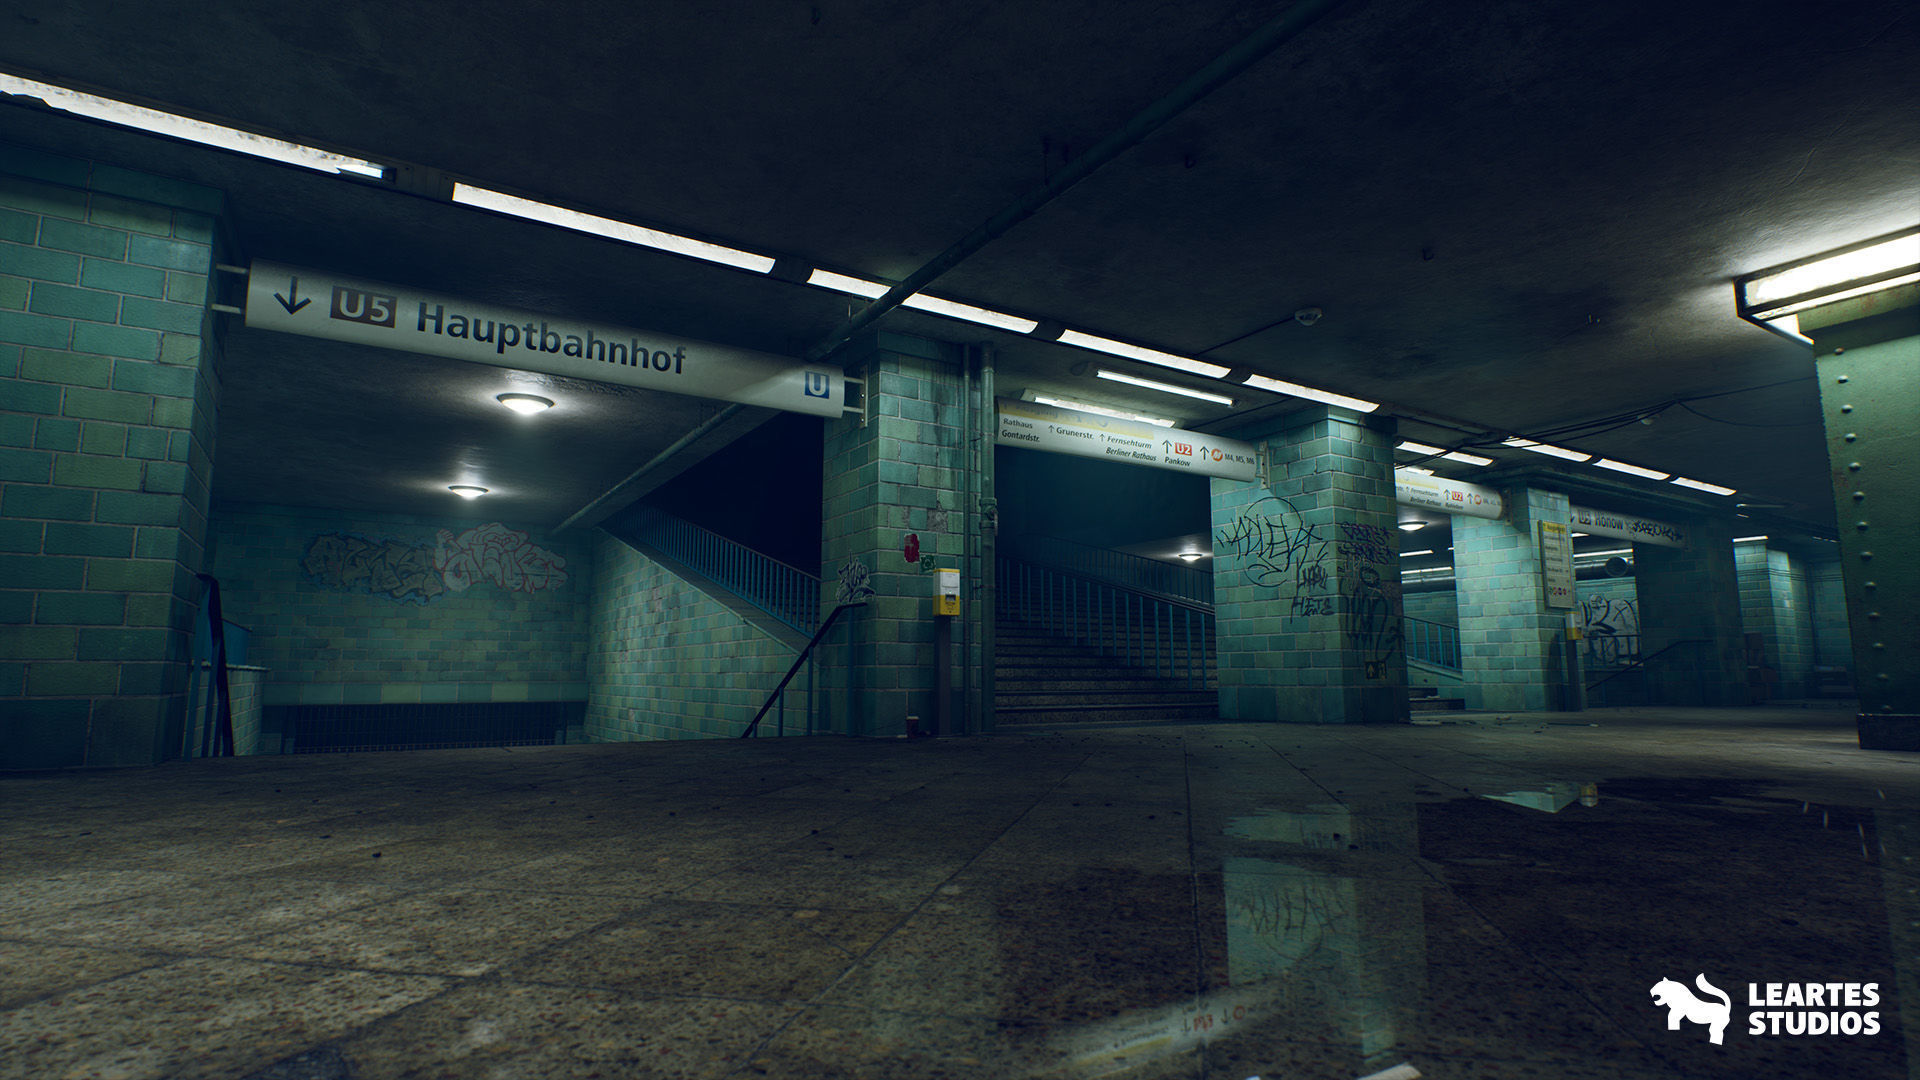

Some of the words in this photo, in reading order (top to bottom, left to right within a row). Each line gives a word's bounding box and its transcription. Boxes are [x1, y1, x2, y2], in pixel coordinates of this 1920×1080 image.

[337, 289, 391, 323] U5
[416, 302, 686, 374] Hauptbahnhof
[808, 373, 828, 397] U
[1003, 417, 1033, 429] Rathaus
[1001, 428, 1041, 442] Gontardstr.
[1056, 426, 1095, 440] Grunerstr.
[1106, 435, 1152, 449] Fernsehturm
[1105, 446, 1131, 458] Berliner
[1132, 450, 1157, 462] Rathaus
[1175, 443, 1192, 456] U2
[1164, 456, 1191, 468] Pankow
[1452, 491, 1463, 501] U2
